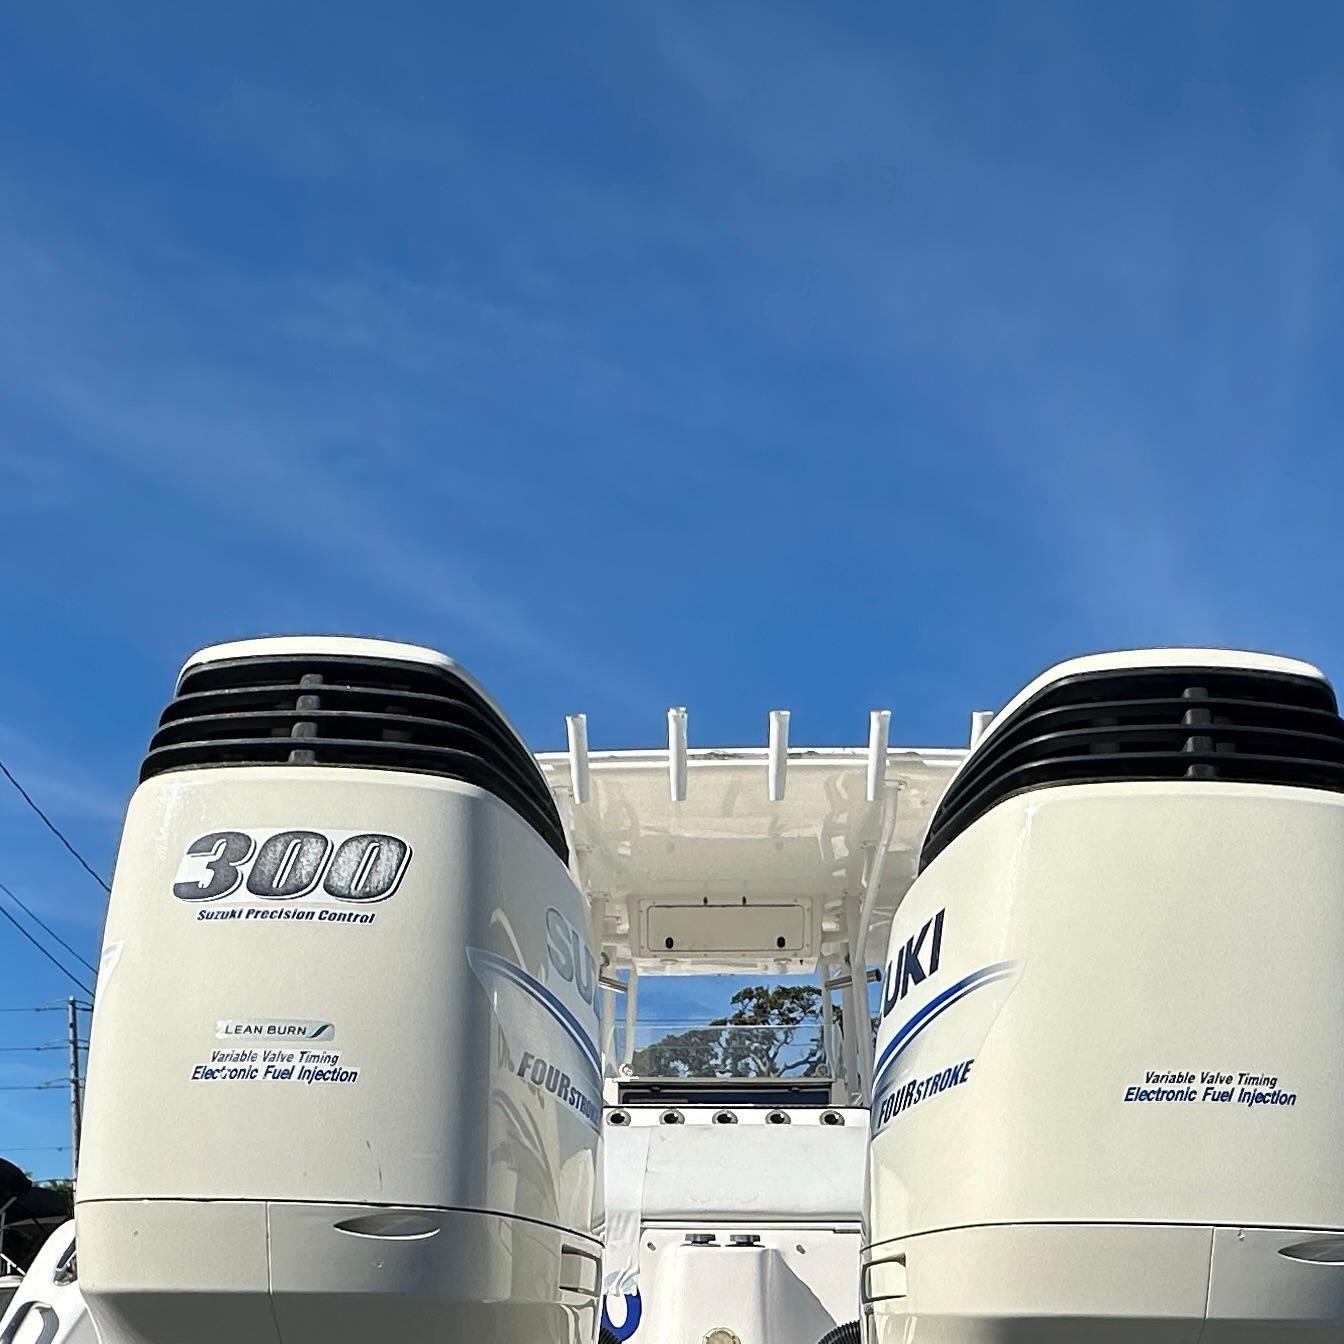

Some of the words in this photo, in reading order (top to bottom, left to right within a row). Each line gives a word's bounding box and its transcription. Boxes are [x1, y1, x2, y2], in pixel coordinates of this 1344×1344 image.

[172, 830, 414, 903] 300
[197, 907, 244, 921] Suzuki
[245, 907, 315, 921] Precision
[317, 909, 376, 924] Control
[883, 907, 946, 1018] UKI
[224, 1024, 263, 1036] LEAN
[266, 1025, 307, 1036] BURN
[211, 1050, 258, 1063] Variable
[261, 1050, 295, 1063] Valve
[297, 1051, 340, 1066] Timing
[262, 1065, 296, 1080] Fuel
[296, 1065, 358, 1084] Injection
[1144, 1071, 1196, 1084] Variable
[1199, 1071, 1234, 1085] Valve
[1237, 1072, 1278, 1089] Timing
[877, 1059, 975, 1129] FOURSTROKE
[1123, 1086, 1198, 1102] Electronic
[1201, 1086, 1235, 1103] Fuel
[1237, 1087, 1297, 1107] Injection
